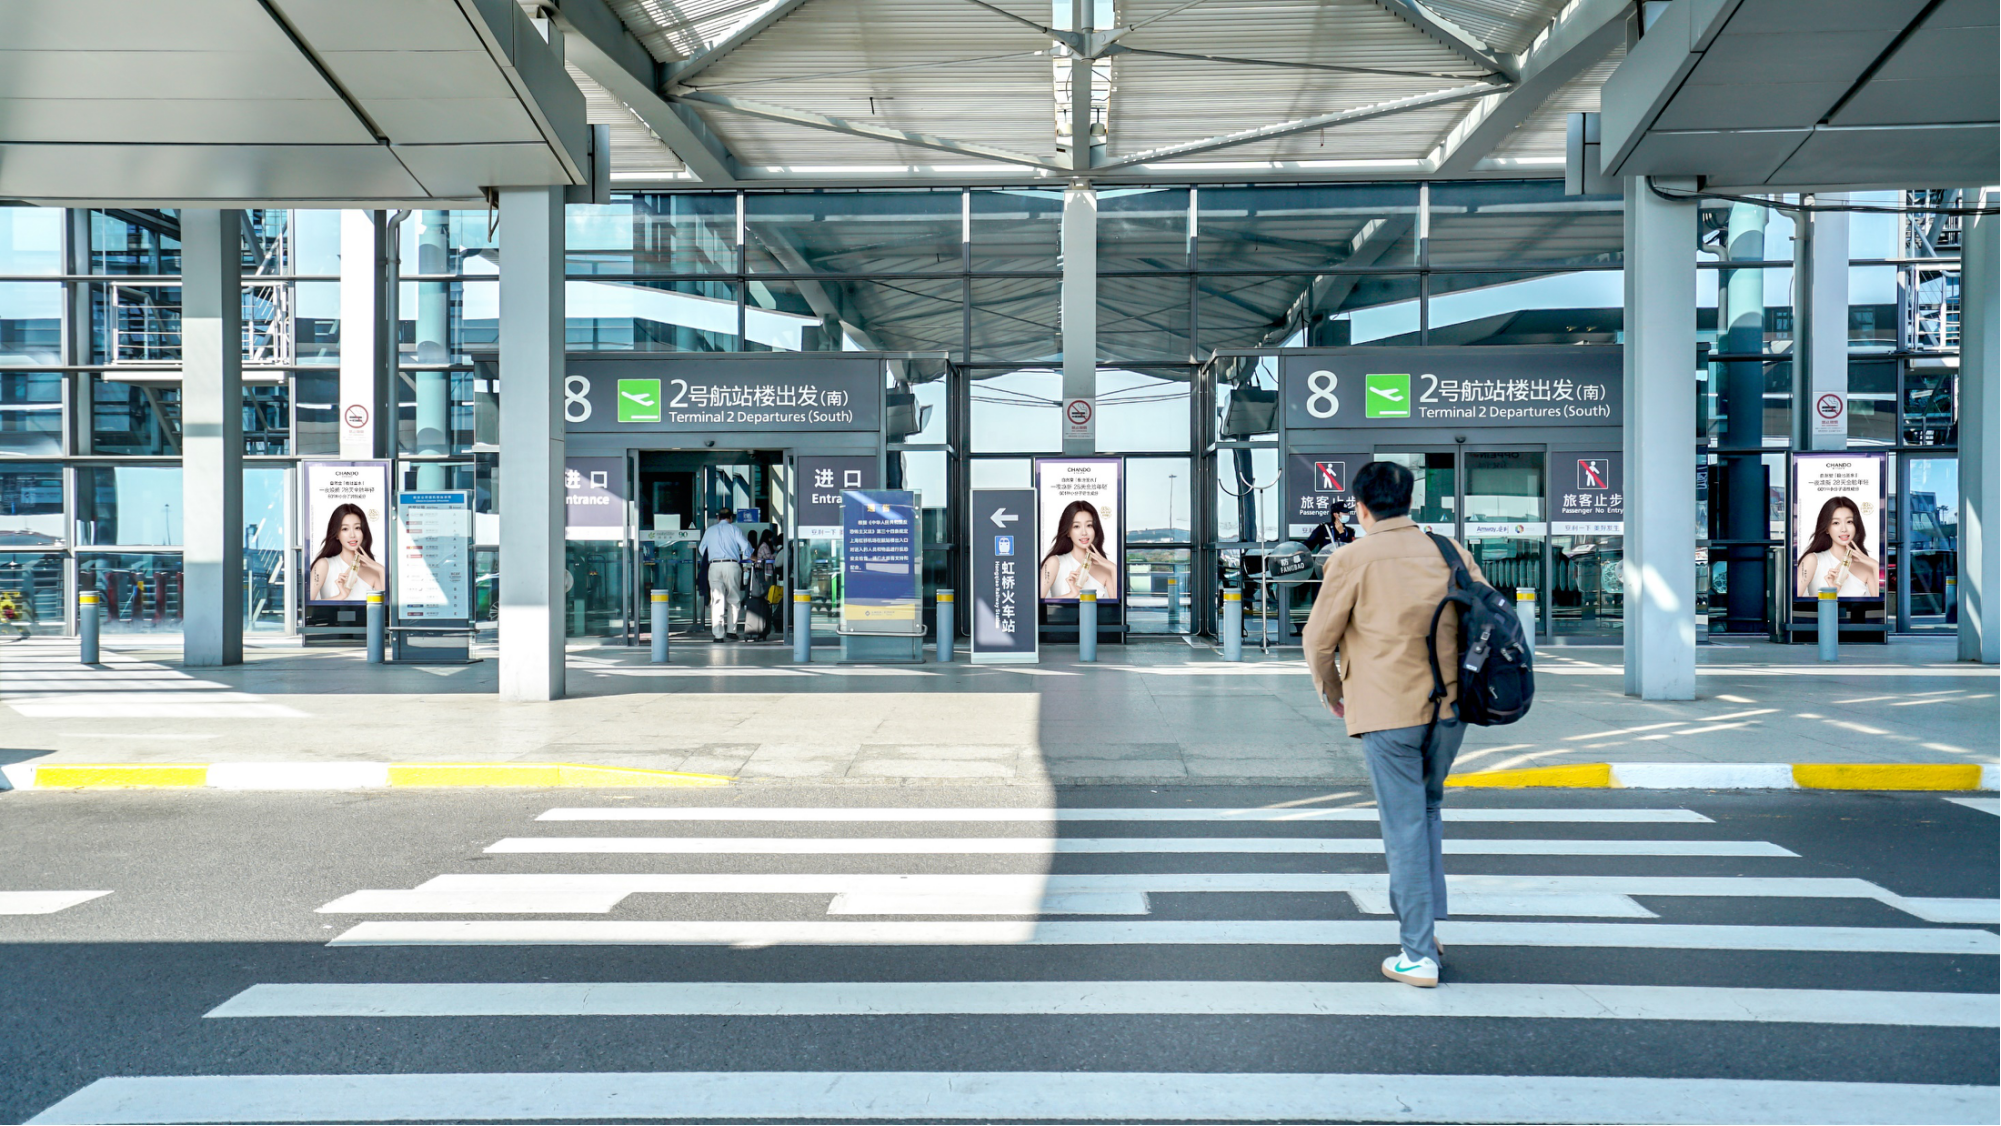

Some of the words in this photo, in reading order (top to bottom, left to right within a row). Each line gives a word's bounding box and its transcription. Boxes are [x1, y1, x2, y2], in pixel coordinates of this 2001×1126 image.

[669, 379, 849, 408] 2号航站楼出发(南)
[1306, 370, 1339, 419] 8
[1419, 373, 1606, 402] 2号航站楼出发(南)
[565, 375, 592, 423] 8
[669, 411, 725, 423] Terminal
[727, 411, 735, 423] 2
[737, 411, 806, 425] Departures
[808, 410, 853, 424] (South)
[1419, 406, 1476, 418] Terminal
[1478, 406, 1487, 418] 2
[1489, 406, 1561, 420] Departures
[1563, 405, 1611, 418] (South)
[814, 468, 862, 488] 进口
[566, 495, 610, 505] ntrance
[812, 493, 843, 504] Entra
[1563, 493, 1623, 507] 旅客止步
[1300, 509, 1329, 517] Passenger
[1562, 507, 1592, 515] Passenger
[1607, 507, 1624, 515] Entry
[1001, 561, 1015, 633] 虹桥火车站
